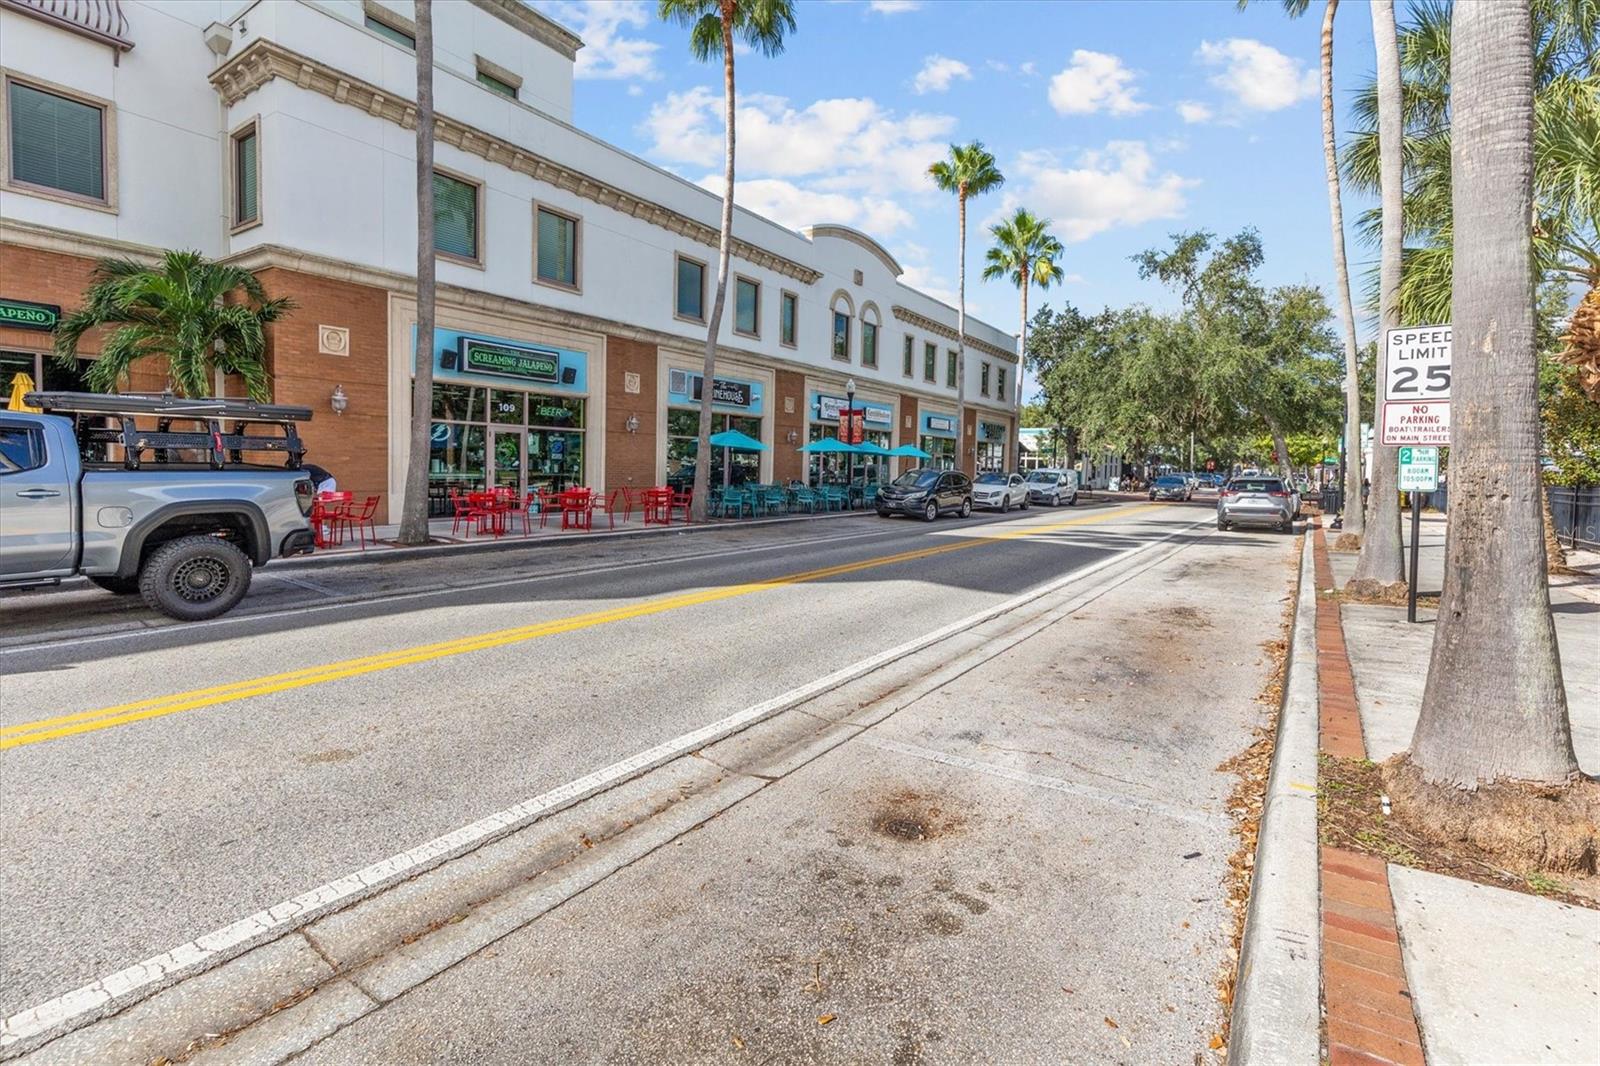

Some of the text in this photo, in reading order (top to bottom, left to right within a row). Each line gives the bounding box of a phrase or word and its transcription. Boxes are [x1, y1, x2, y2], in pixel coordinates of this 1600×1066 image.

[1393, 331, 1452, 345] SPEED
[473, 351, 517, 367] SCREAMING
[1399, 346, 1447, 360] LIMIT
[1391, 365, 1451, 393] 25
[499, 403, 515, 412] 109
[540, 407, 562, 416] BEER
[1412, 405, 1429, 414] NO
[1400, 415, 1440, 424] PARKING
[1402, 450, 1411, 462] 2
